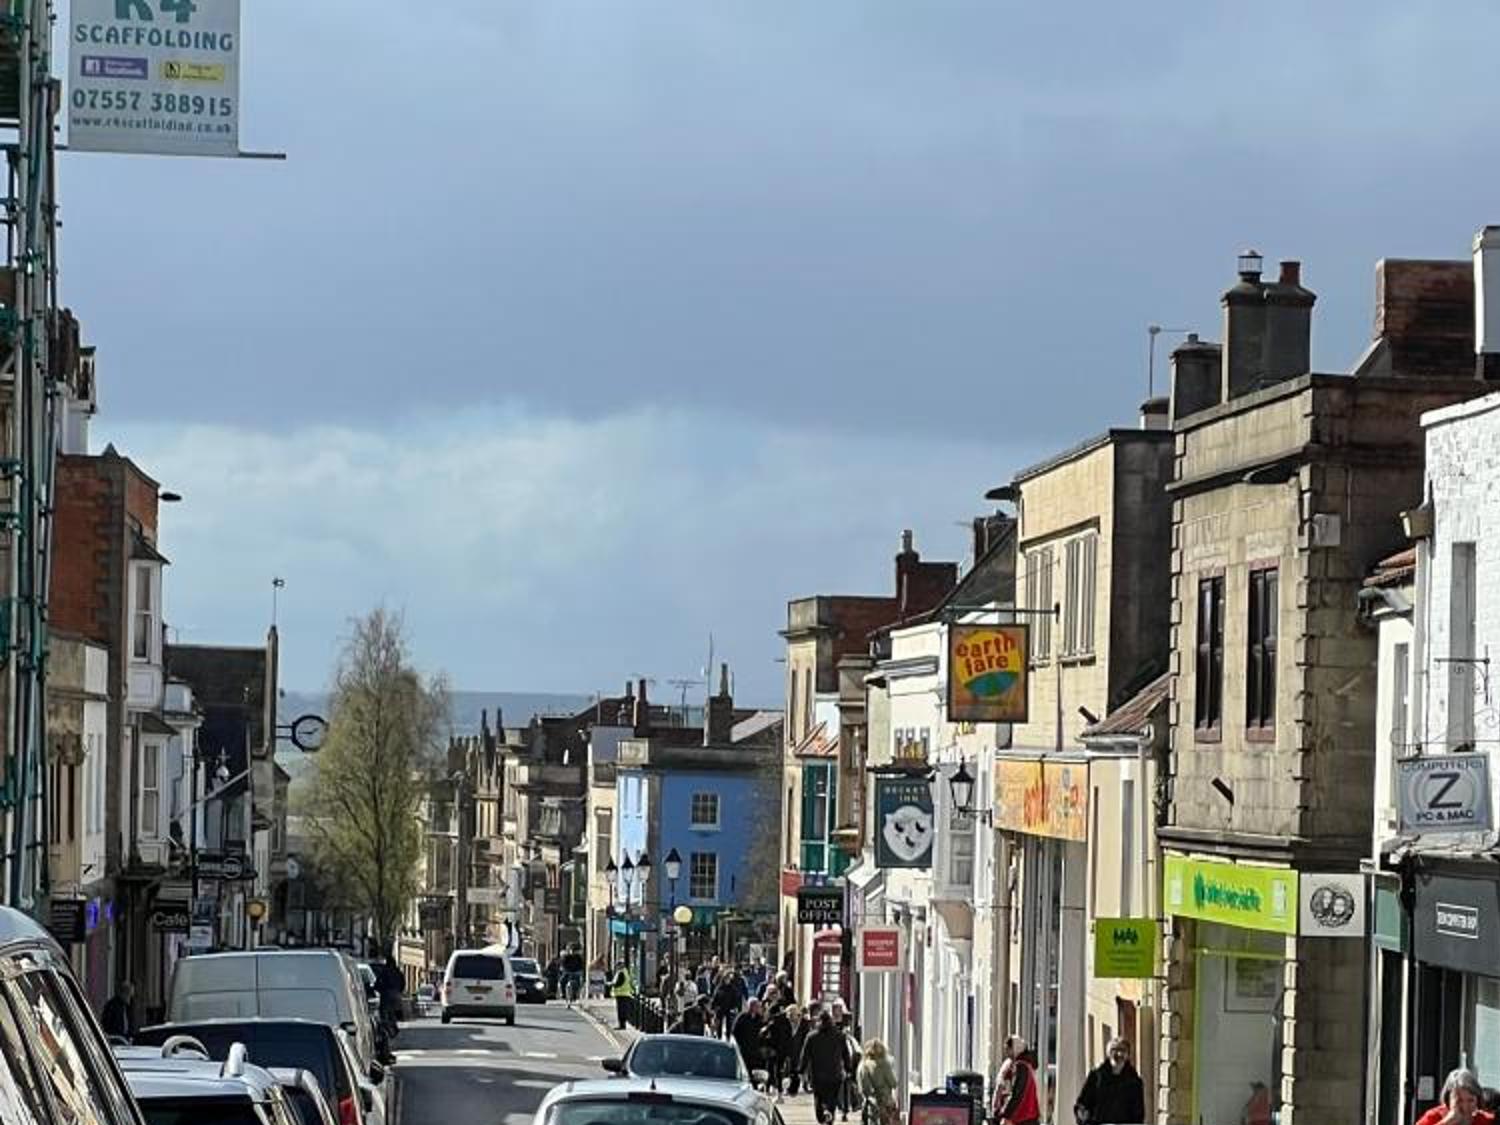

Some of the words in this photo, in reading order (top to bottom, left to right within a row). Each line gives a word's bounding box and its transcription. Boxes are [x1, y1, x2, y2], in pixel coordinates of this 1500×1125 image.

[75, 24, 232, 51] SCAFFOLDING
[73, 89, 141, 110] 07557
[151, 93, 231, 116] 388915
[956, 632, 1016, 658] earth
[965, 655, 1009, 677] fare
[1428, 772, 1462, 809] Z
[1416, 811, 1433, 821] PC
[1436, 811, 1445, 820] &
[1447, 809, 1475, 819] MAC
[799, 909, 842, 921] OFFICE
[805, 899, 838, 910] POST
